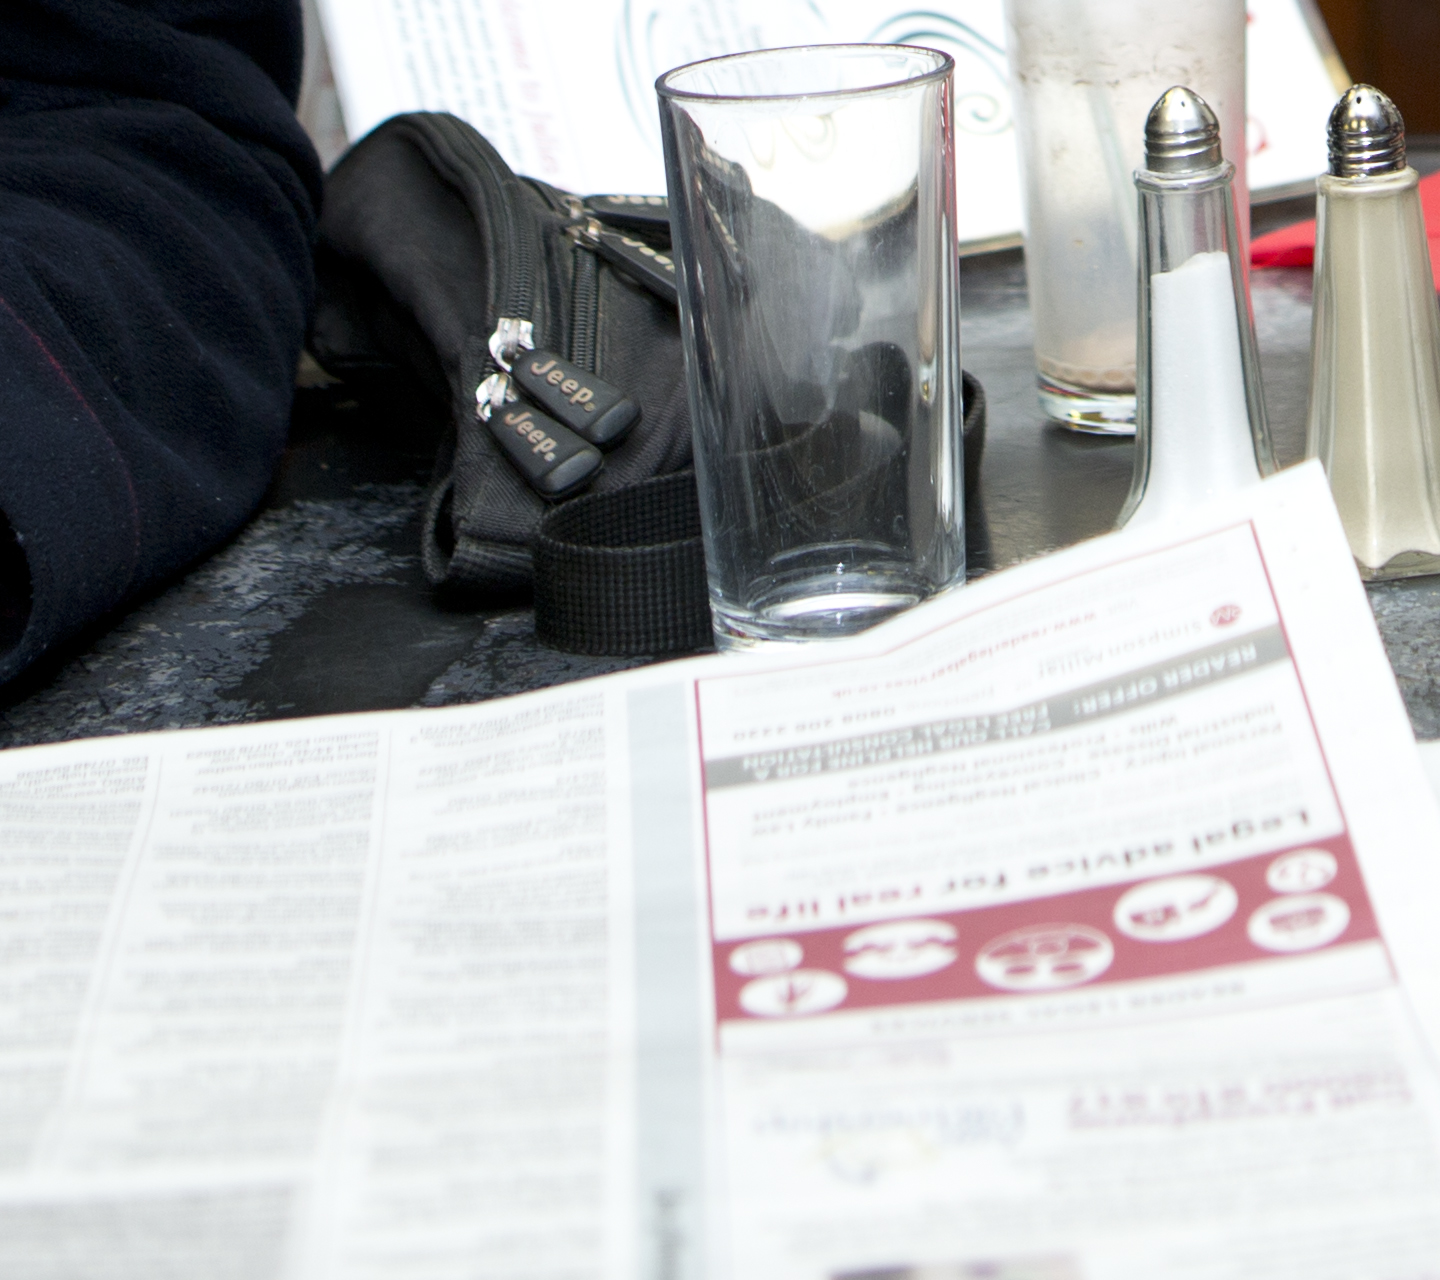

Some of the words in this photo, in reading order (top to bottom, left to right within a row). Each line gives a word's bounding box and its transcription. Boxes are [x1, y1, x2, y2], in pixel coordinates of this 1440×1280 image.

[530, 359, 594, 406] Jeep
[503, 410, 558, 454] Jeep
[1162, 642, 1257, 689] READER
[1073, 675, 1158, 715] OFFER:
[742, 726, 914, 770] CONSULTATION
[776, 759, 822, 777] FOR
[827, 739, 934, 771] HELPLINE
[1191, 807, 1309, 855] Legal
[1026, 839, 1174, 880] advice
[837, 882, 922, 916] real
[941, 870, 1008, 895] for
[746, 897, 819, 922] life
